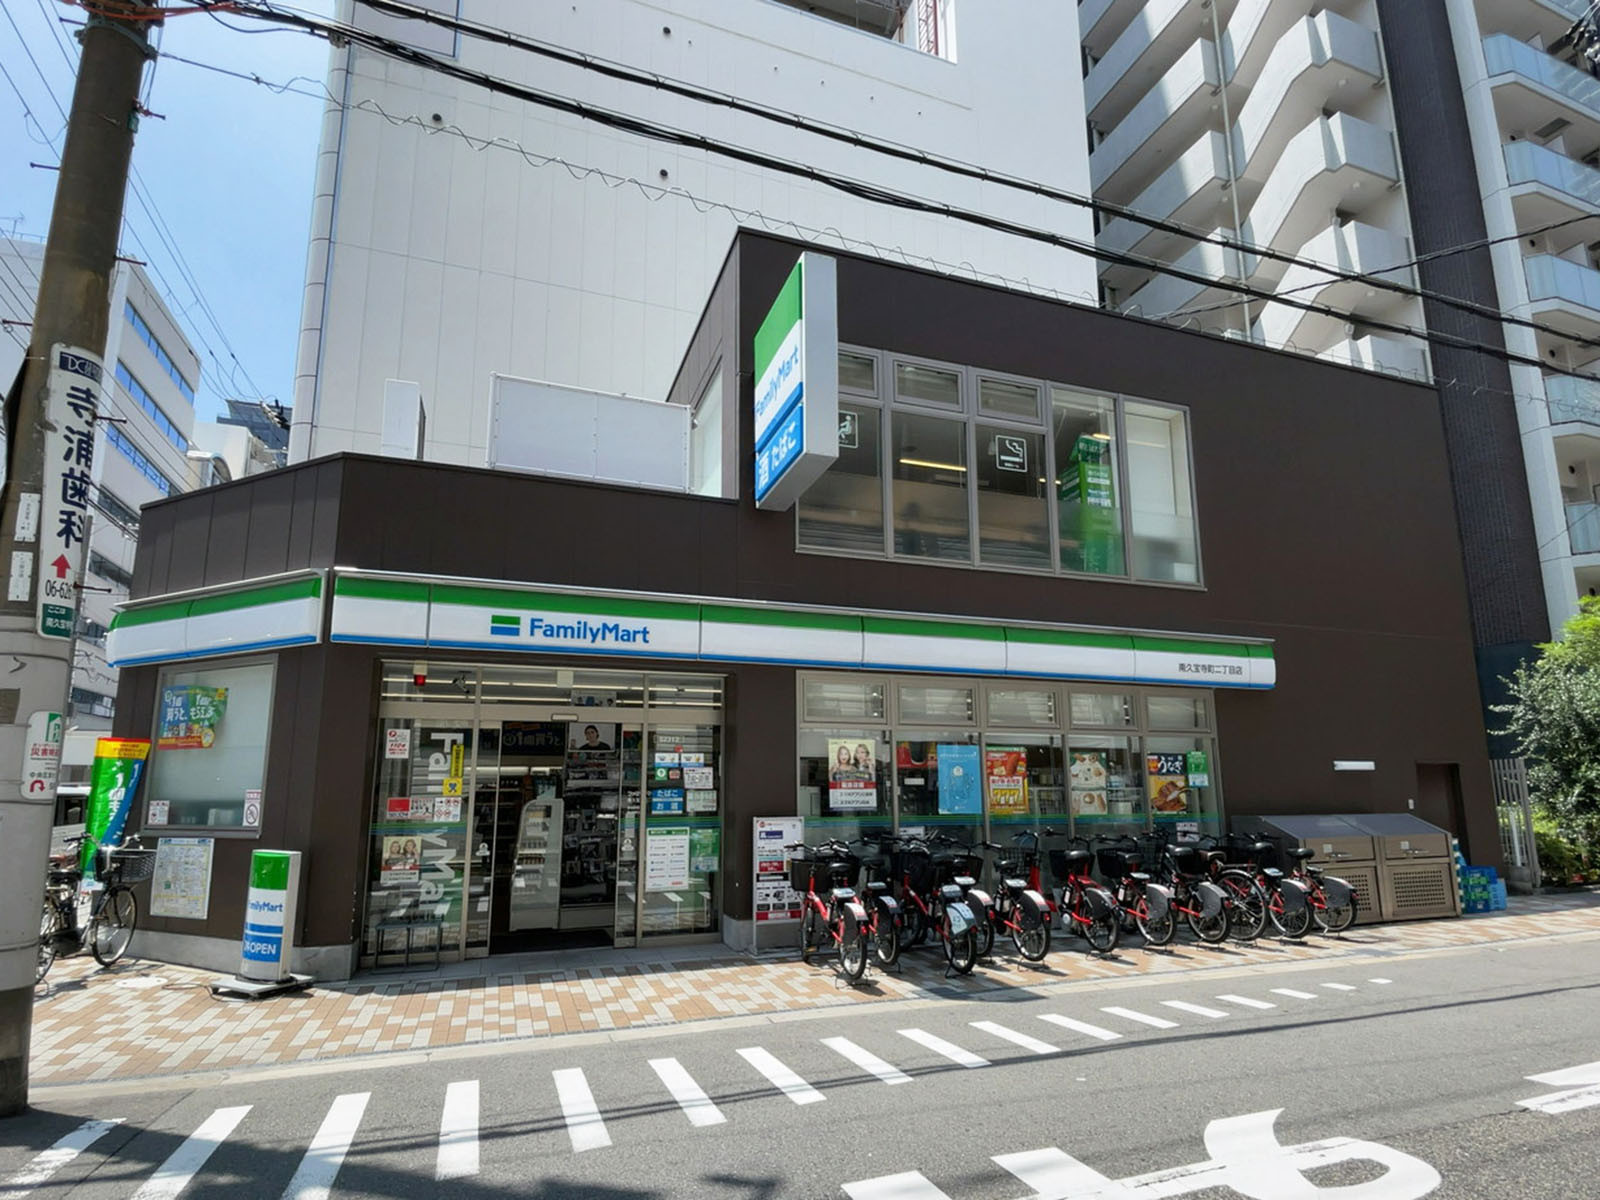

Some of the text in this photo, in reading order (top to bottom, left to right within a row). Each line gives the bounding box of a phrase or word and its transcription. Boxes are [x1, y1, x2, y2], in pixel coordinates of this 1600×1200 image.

[755, 346, 799, 419] FamilyMart
[771, 420, 796, 472] たばこ
[529, 617, 650, 644] FamilyMart
[1178, 663, 1243, 675] 南久宝寺町二丁目店
[657, 789, 679, 798] たばこ
